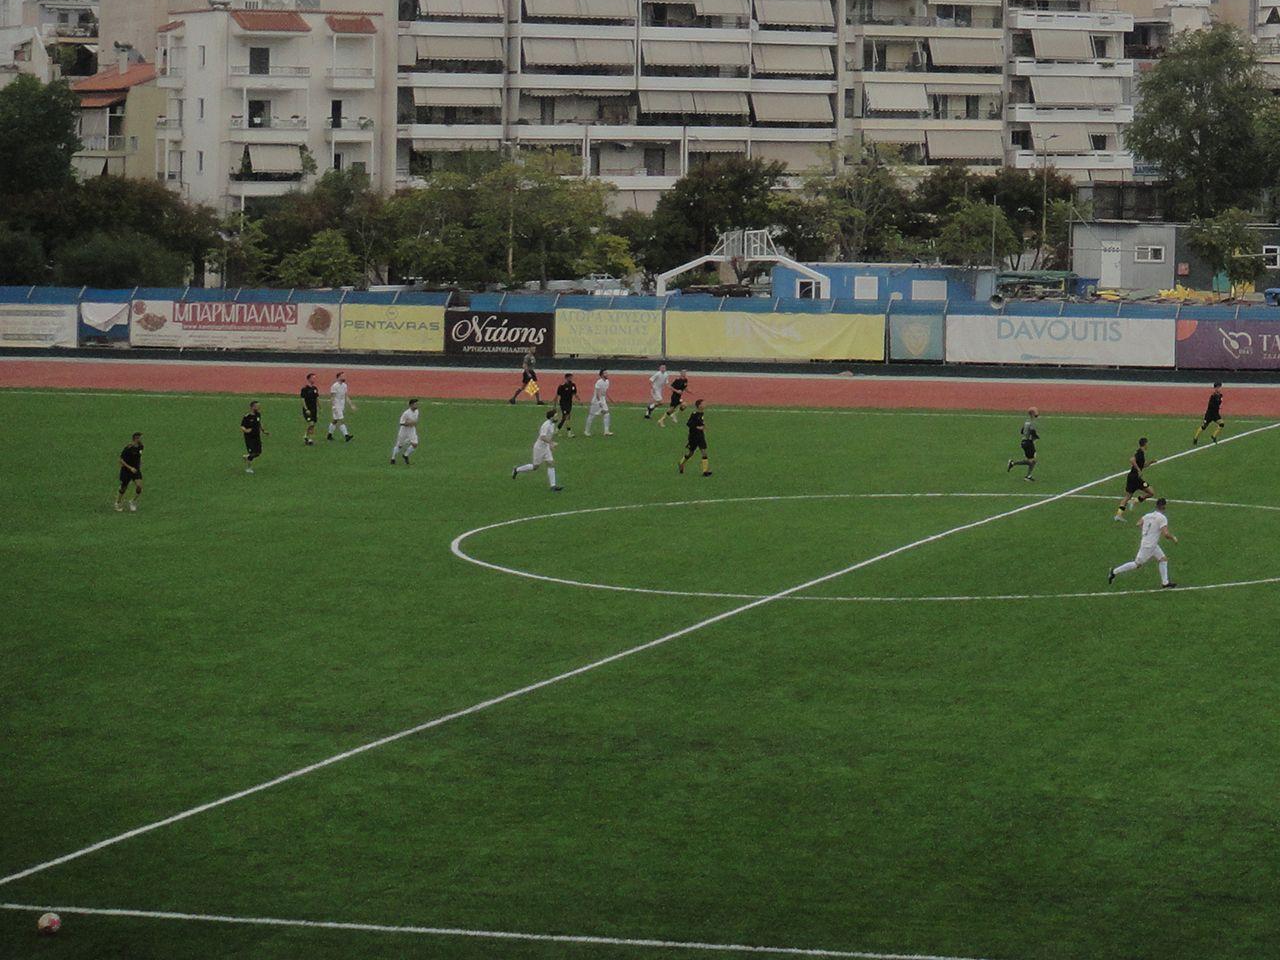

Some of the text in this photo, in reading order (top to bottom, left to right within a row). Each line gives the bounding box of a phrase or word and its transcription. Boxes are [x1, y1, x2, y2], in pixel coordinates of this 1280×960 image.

[174, 303, 297, 323] ΜΠΑΡΜΠΑΛΙΑΣ
[343, 320, 440, 331] PENTAVRAS
[996, 318, 1122, 342] DAVOUTIS
